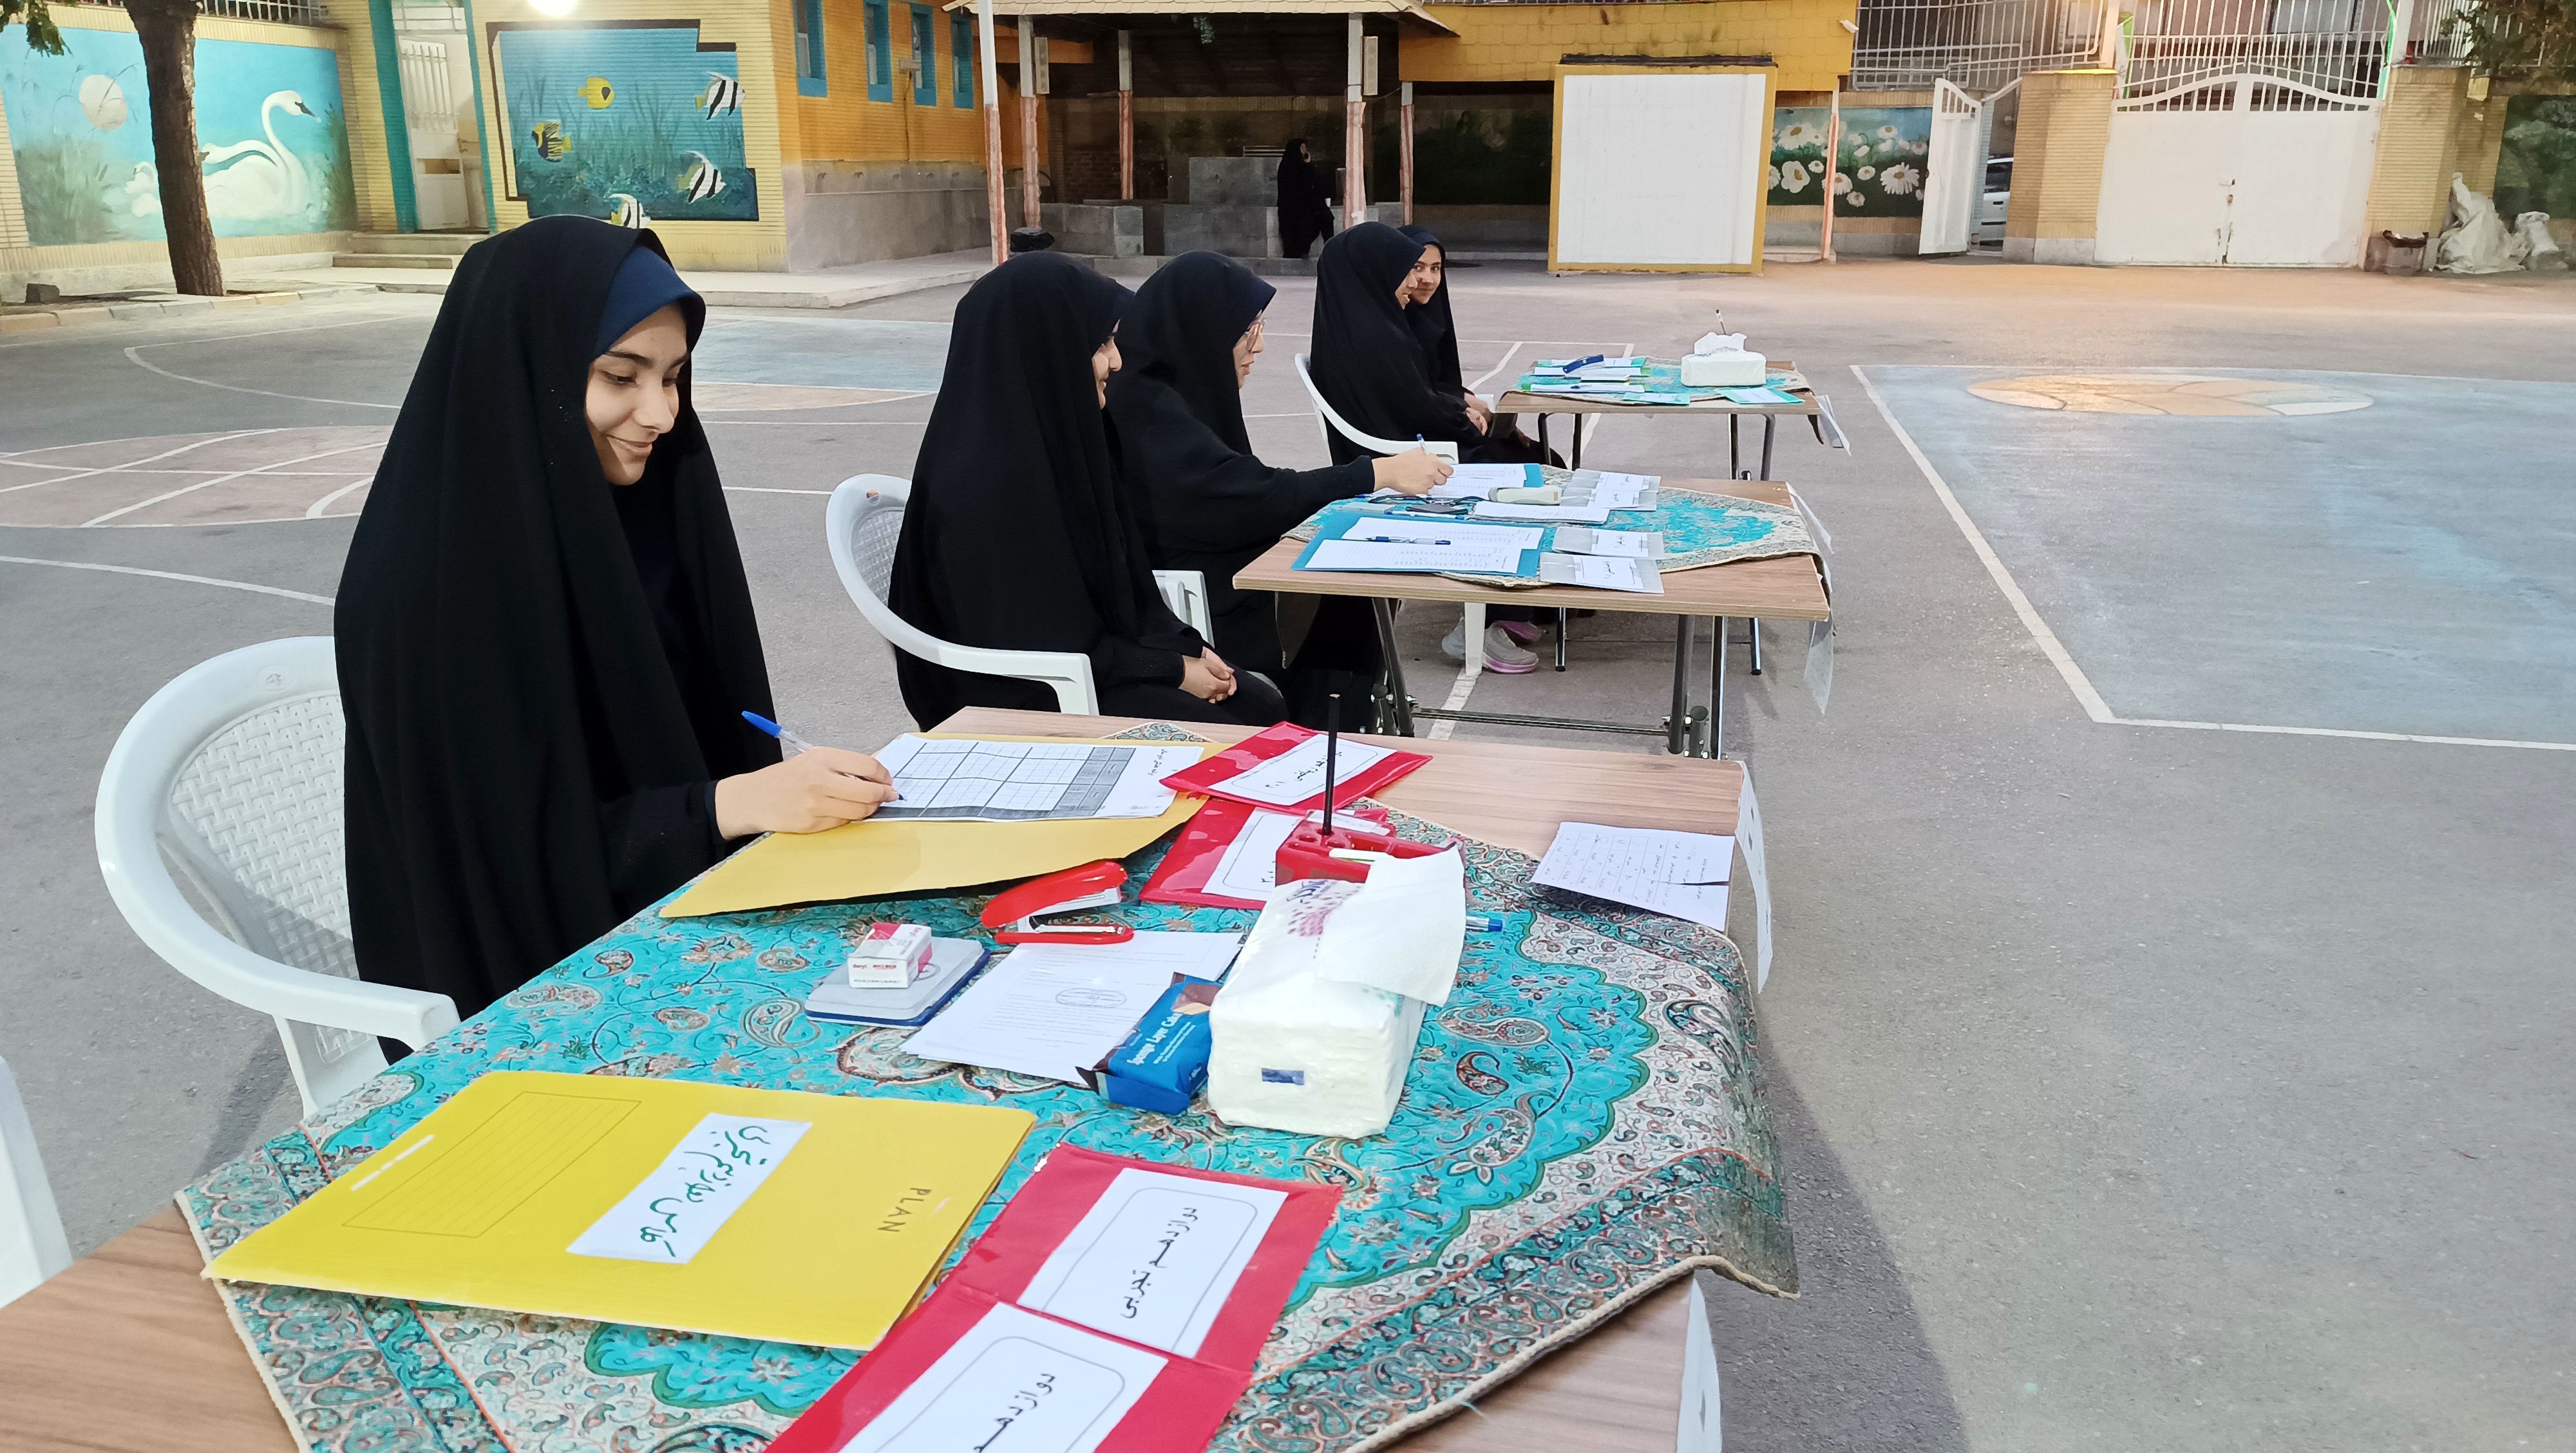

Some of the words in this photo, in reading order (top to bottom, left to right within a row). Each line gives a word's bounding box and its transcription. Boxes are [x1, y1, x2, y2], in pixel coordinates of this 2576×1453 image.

[640, 1197, 683, 1257] کلاس
[678, 1150, 734, 1203] دوازدهم
[710, 1125, 771, 1166] تجربی
[877, 1187, 932, 1232] PLAN
[1149, 1207, 1198, 1269] دوازدهم
[1120, 1269, 1151, 1319] تجربی
